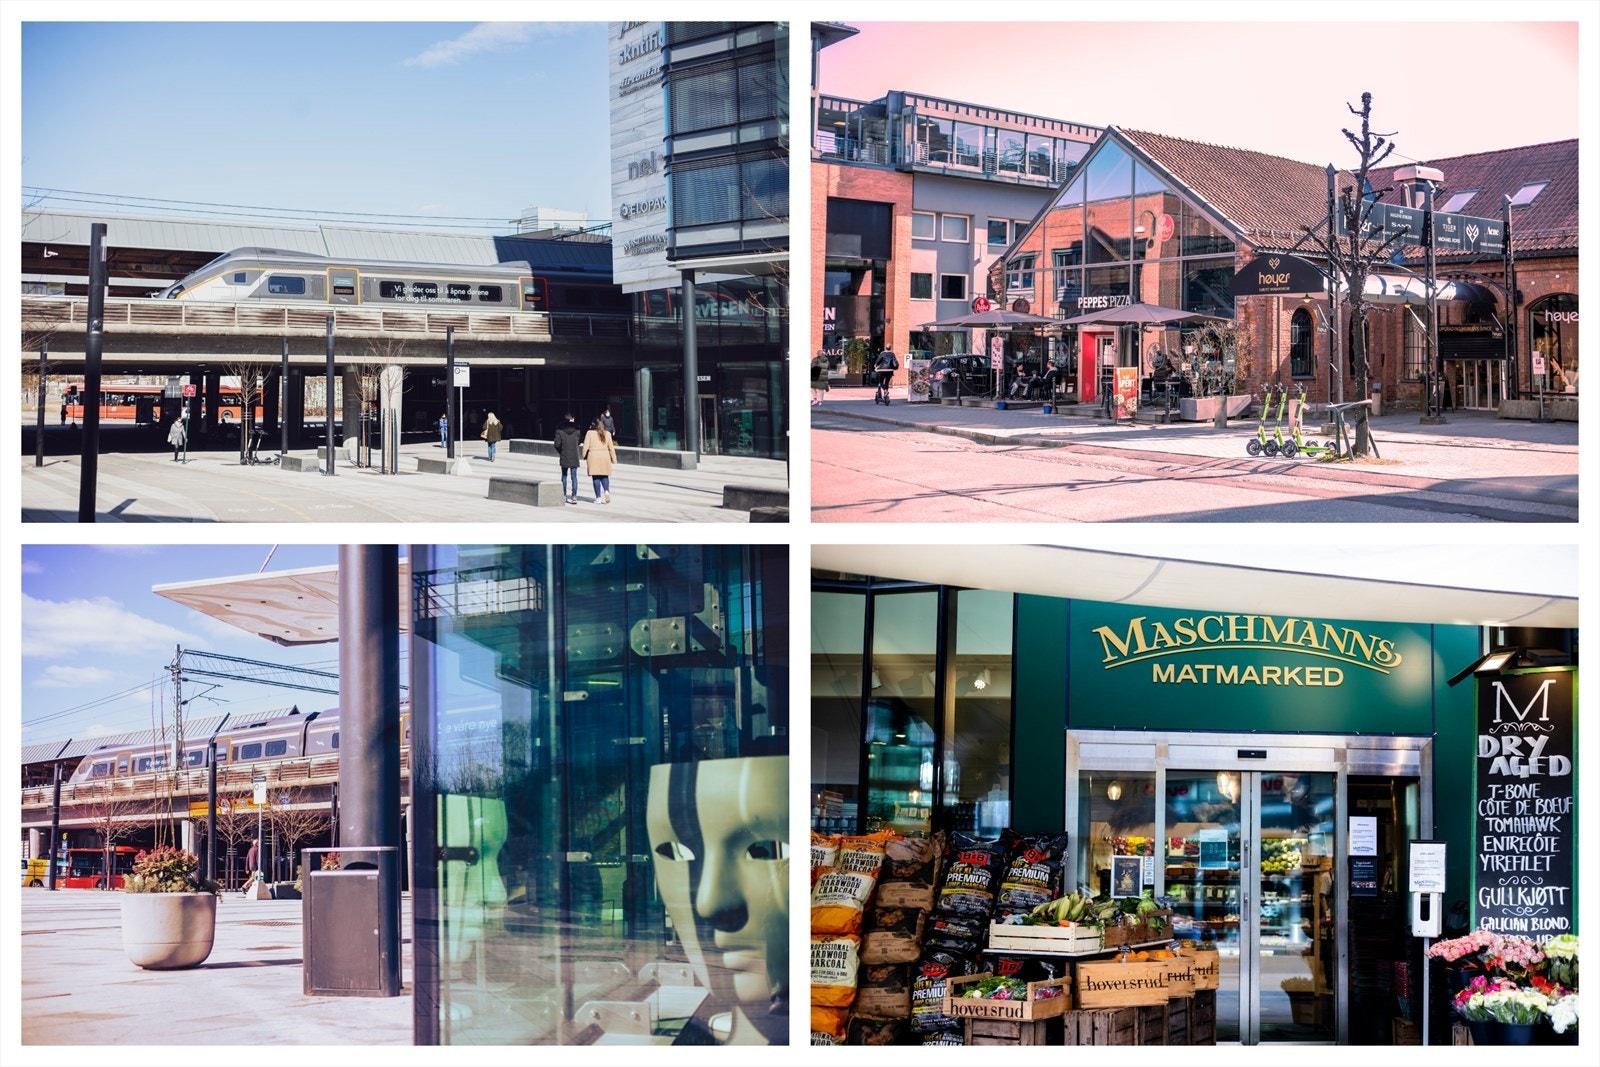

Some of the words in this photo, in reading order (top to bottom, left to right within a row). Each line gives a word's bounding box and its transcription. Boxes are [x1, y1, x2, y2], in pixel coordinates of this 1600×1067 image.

[1258, 271, 1291, 287] høyer
[1077, 295, 1108, 309] PEPPES
[1109, 294, 1131, 308] PIZZA
[1152, 663, 1344, 687] MATMARKED
[1491, 679, 1557, 723] M
[479, 719, 497, 732] nye
[1477, 734, 1550, 758] DRY
[1488, 754, 1572, 779] AGED
[1487, 783, 1542, 800] T-BONE
[1478, 797, 1511, 817] CÔTE
[1515, 799, 1531, 816] DE
[1484, 816, 1562, 834] TOMAHAWK
[1483, 833, 1561, 854] ENTRECÔTE
[1480, 853, 1556, 873] YTREFILET
[946, 873, 991, 887] PREMIUM
[1008, 867, 1049, 882] PREMIUM
[818, 886, 857, 897] CHARCOAL
[820, 879, 861, 889] HARDWOOD
[1478, 886, 1571, 909] GULLKJØTT
[1480, 916, 1529, 932] GALICIAN
[811, 943, 850, 951] ROFESSIONAL
[811, 950, 848, 960] ARDWOOD
